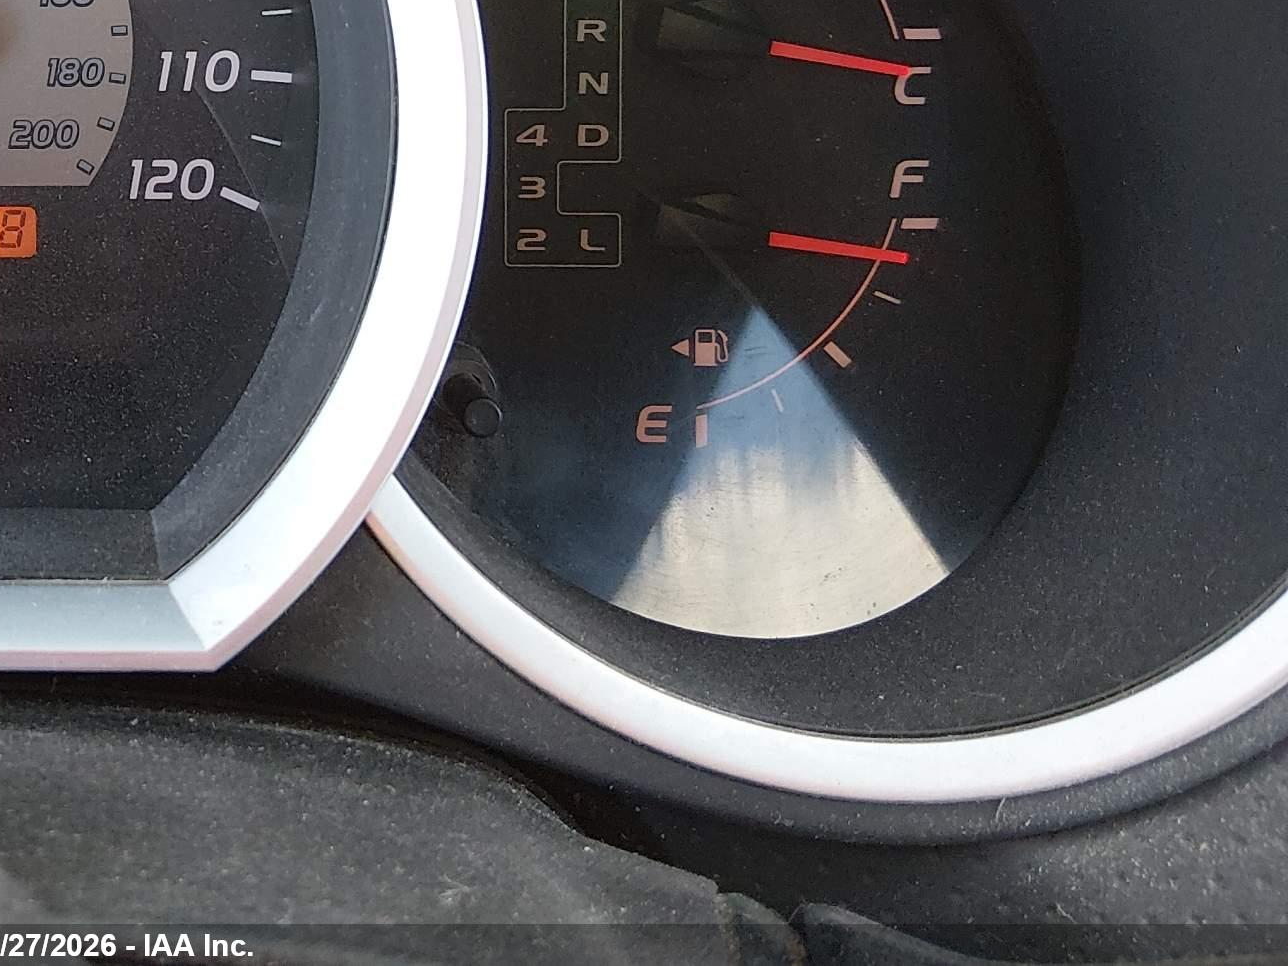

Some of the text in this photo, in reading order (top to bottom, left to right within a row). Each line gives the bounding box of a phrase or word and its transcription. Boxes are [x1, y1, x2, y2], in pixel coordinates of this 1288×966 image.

[576, 18, 607, 42] R
[47, 57, 106, 87] 180
[157, 50, 241, 93] 110
[578, 71, 609, 95] N
[894, 66, 932, 105] C
[8, 119, 80, 149] 200
[516, 124, 549, 147] 4
[576, 124, 610, 147] D
[128, 158, 216, 202] 120
[518, 176, 547, 199] 3
[889, 159, 930, 199] F
[516, 228, 547, 252] 2
[579, 228, 606, 252] L
[635, 404, 674, 444] E
